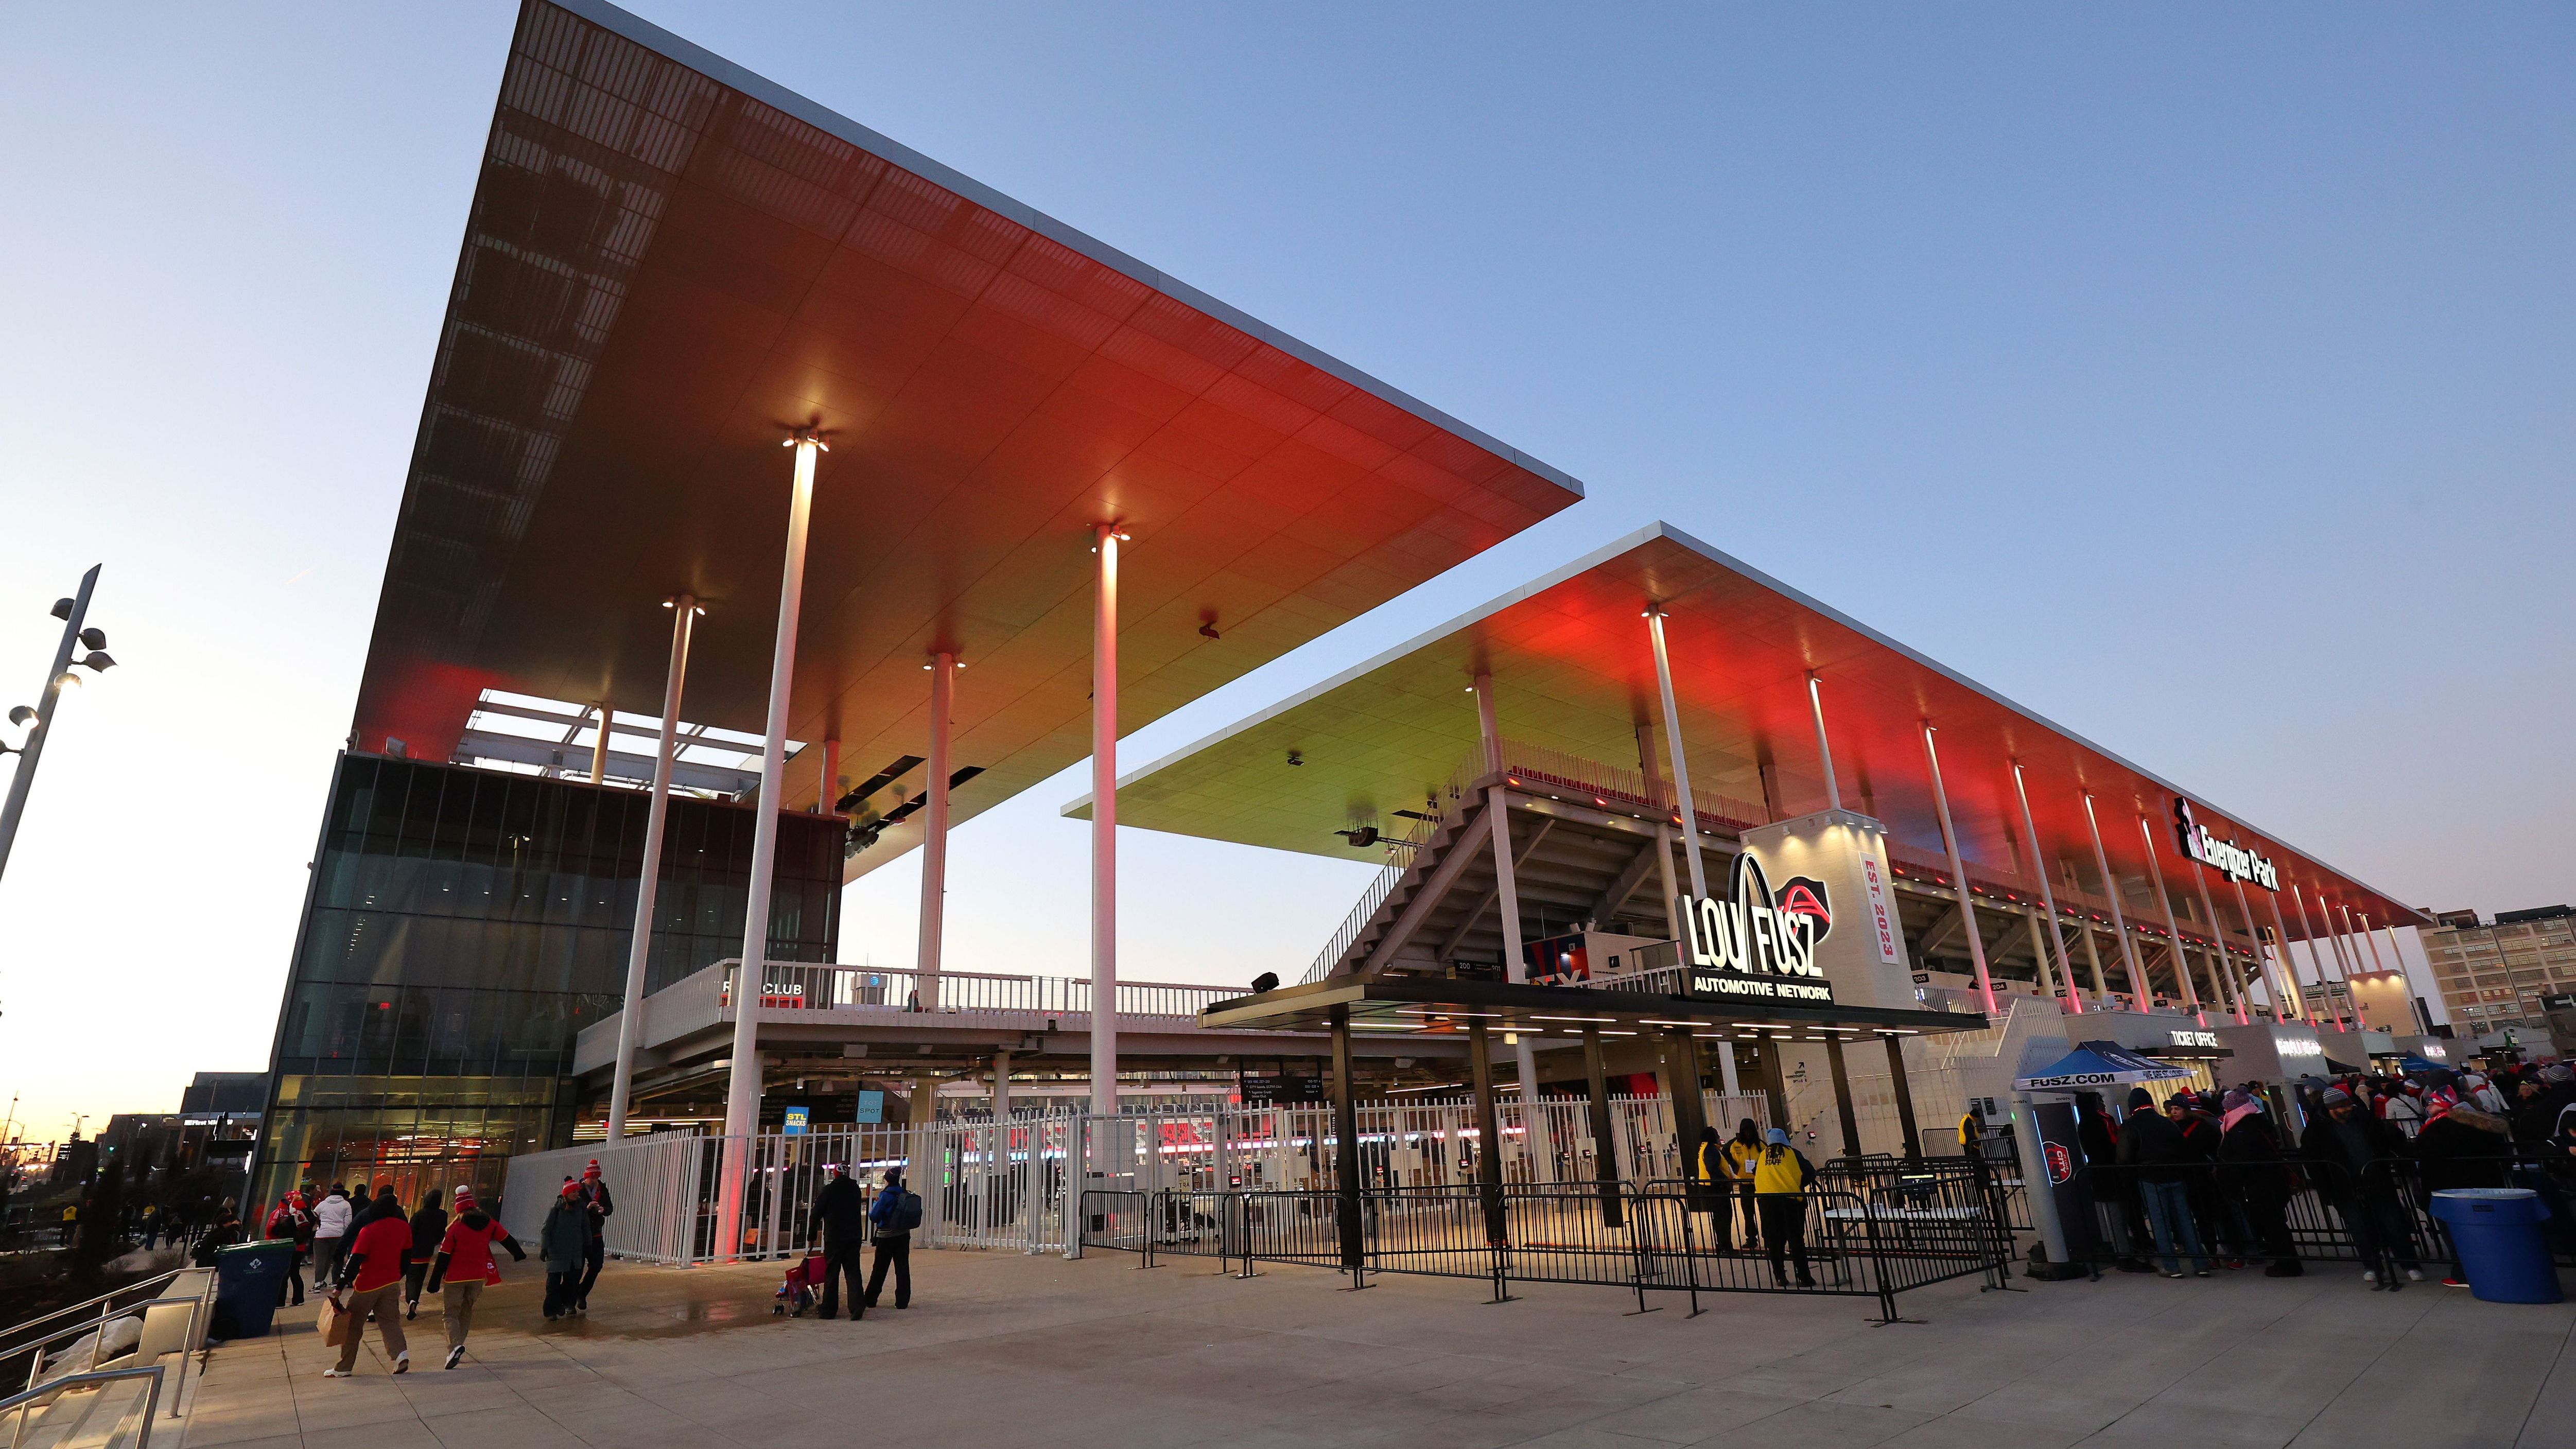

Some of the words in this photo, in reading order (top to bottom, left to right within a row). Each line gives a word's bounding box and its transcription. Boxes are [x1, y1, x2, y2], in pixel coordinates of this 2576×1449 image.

[2199, 824, 2252, 883] Energizer
[2249, 848, 2280, 892] Park
[1865, 860, 1881, 898] EST.
[1874, 903, 1893, 956] 2023
[1683, 894, 1745, 971] LOU
[1751, 905, 1823, 977] FUSZ
[762, 983, 803, 995] CLUB
[1694, 976, 1774, 997] AUTOMOTIVE
[1776, 984, 1832, 1001] NETWORK
[2170, 1031, 2196, 1046] TICKET
[2195, 1032, 2218, 1047] OFFICE
[2030, 1074, 2115, 1087] FUSZ.COM
[2057, 1150, 2066, 1173] CITY
